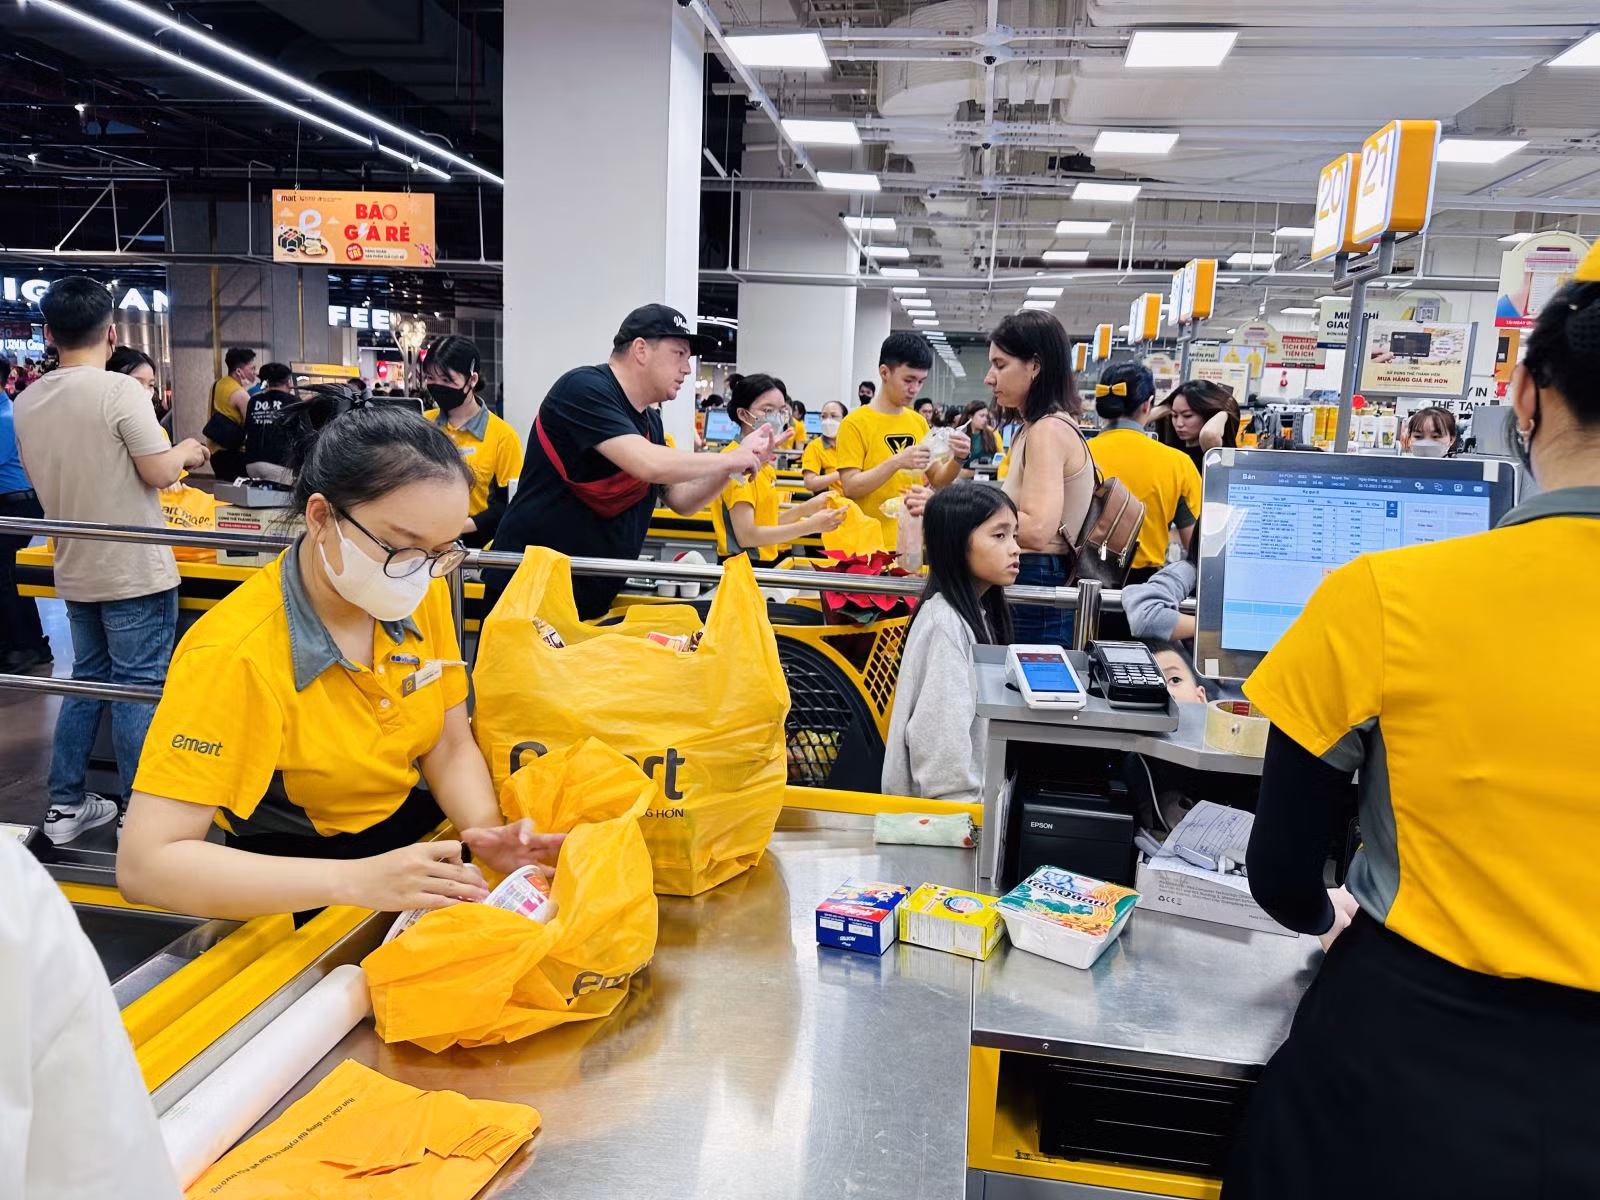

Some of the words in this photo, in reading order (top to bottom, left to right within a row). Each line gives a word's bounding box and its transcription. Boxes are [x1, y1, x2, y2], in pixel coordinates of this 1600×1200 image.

[1363, 132, 1390, 198] 21
[1318, 162, 1344, 221] 20
[171, 733, 224, 757] emart
[1030, 821, 1054, 830] EPSON
